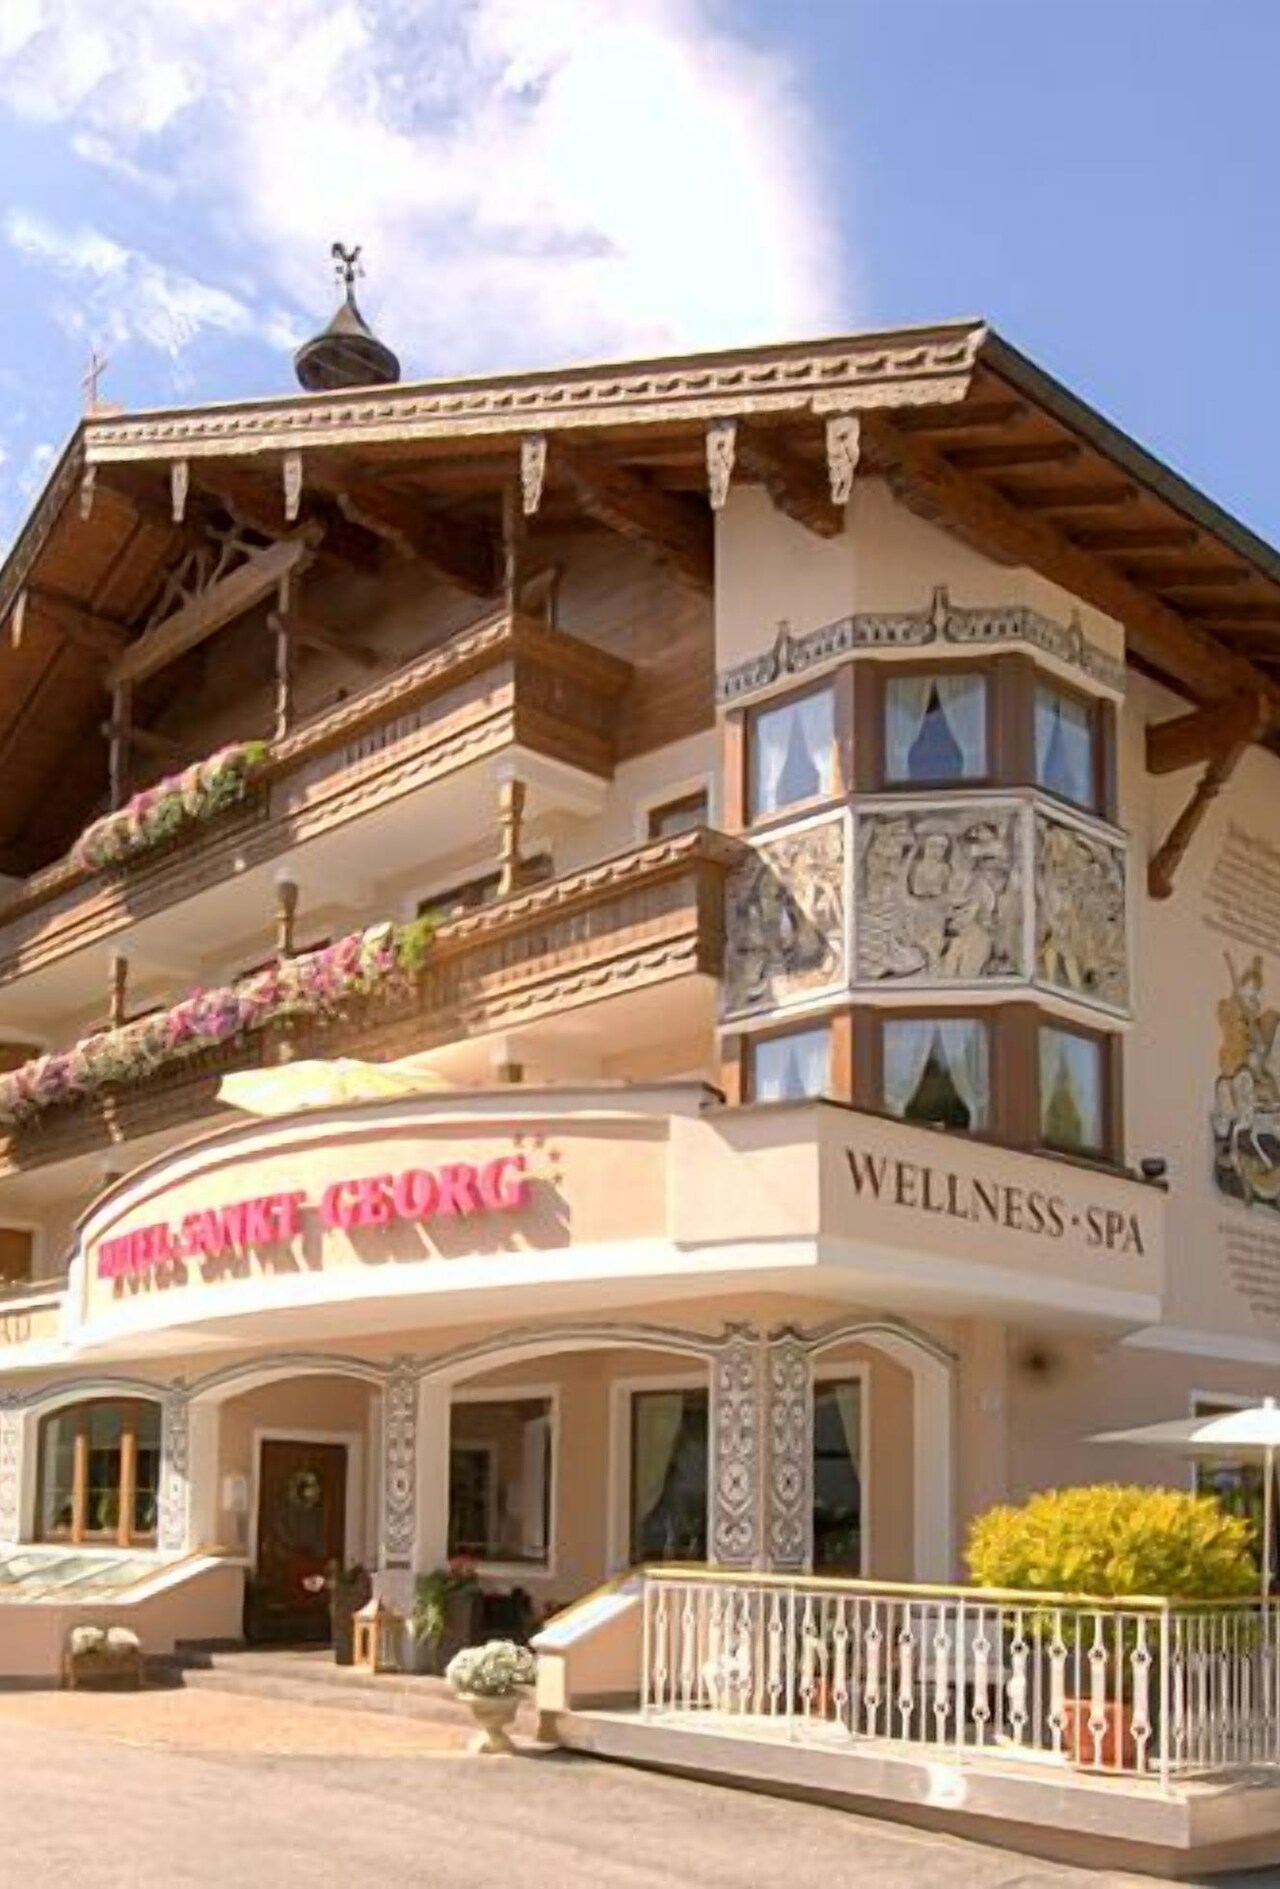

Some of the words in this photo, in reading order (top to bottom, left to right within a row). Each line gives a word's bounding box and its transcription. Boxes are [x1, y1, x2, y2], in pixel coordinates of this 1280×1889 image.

[320, 1154, 531, 1231] GEORG
[846, 1147, 1065, 1238] WELLNESS
[1086, 1205, 1145, 1256] SPA
